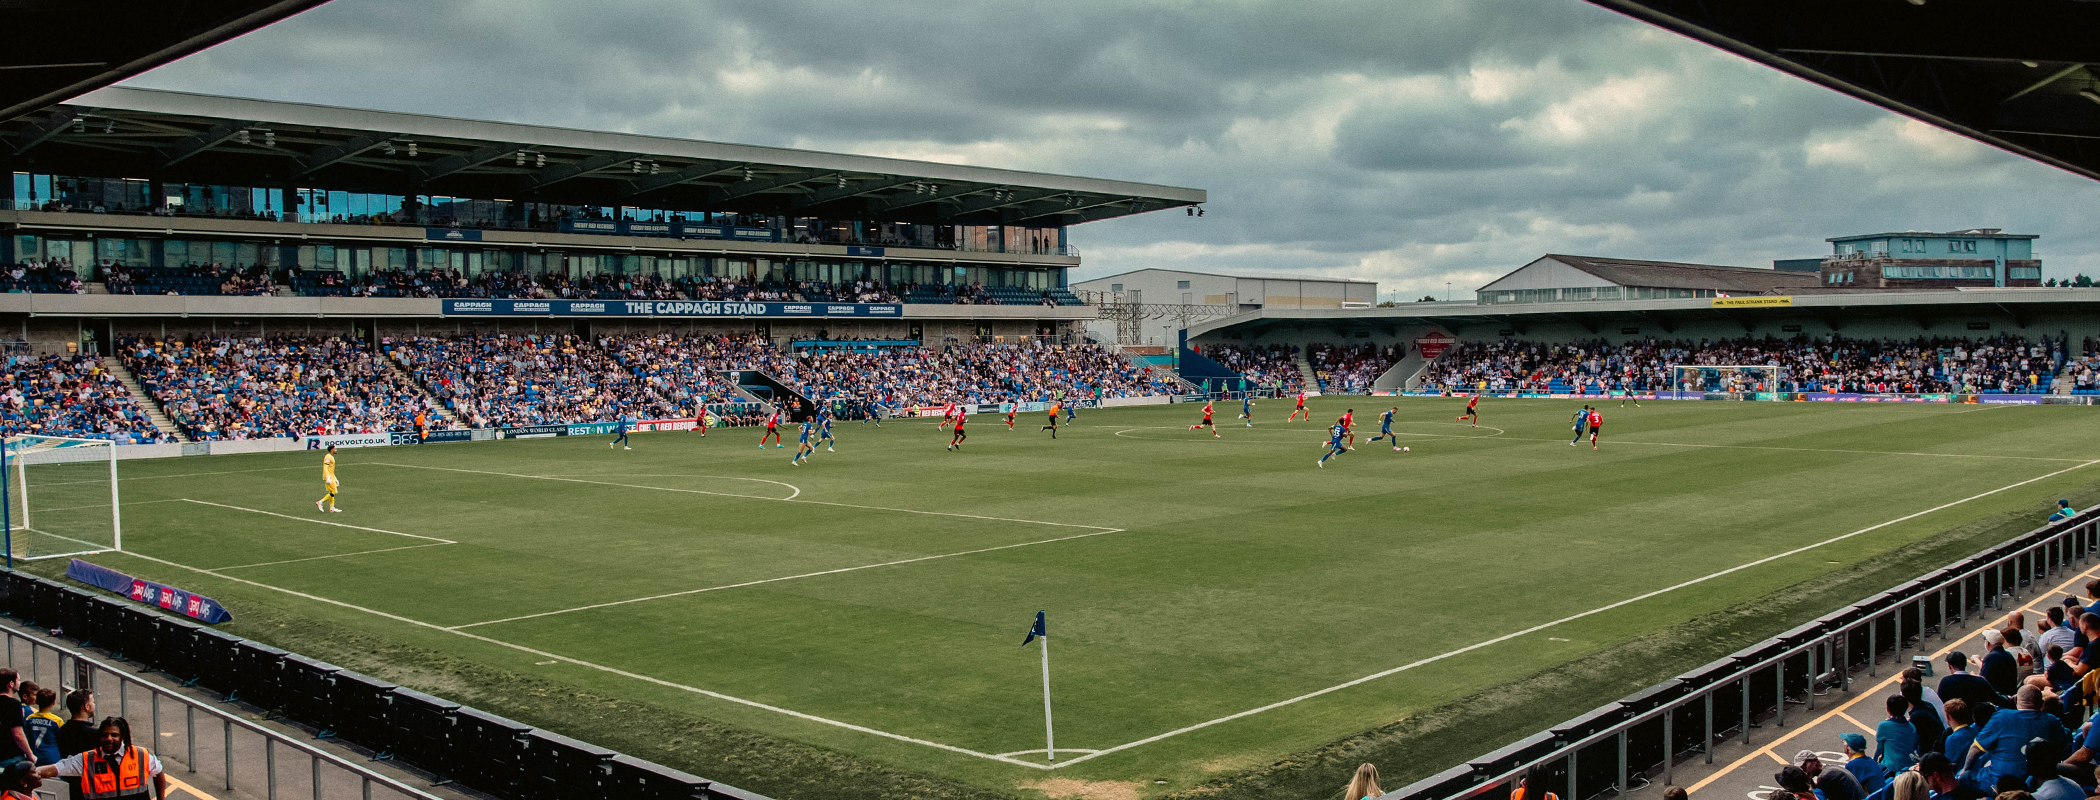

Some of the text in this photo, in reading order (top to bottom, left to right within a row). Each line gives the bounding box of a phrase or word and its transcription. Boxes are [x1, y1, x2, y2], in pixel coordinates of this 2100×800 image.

[625, 302, 766, 314] THE CAPPAGH STAND
[607, 424, 636, 434] WTE
[639, 423, 660, 431] CHEY
[673, 422, 698, 430] RECORD
[32, 726, 47, 748] 7
